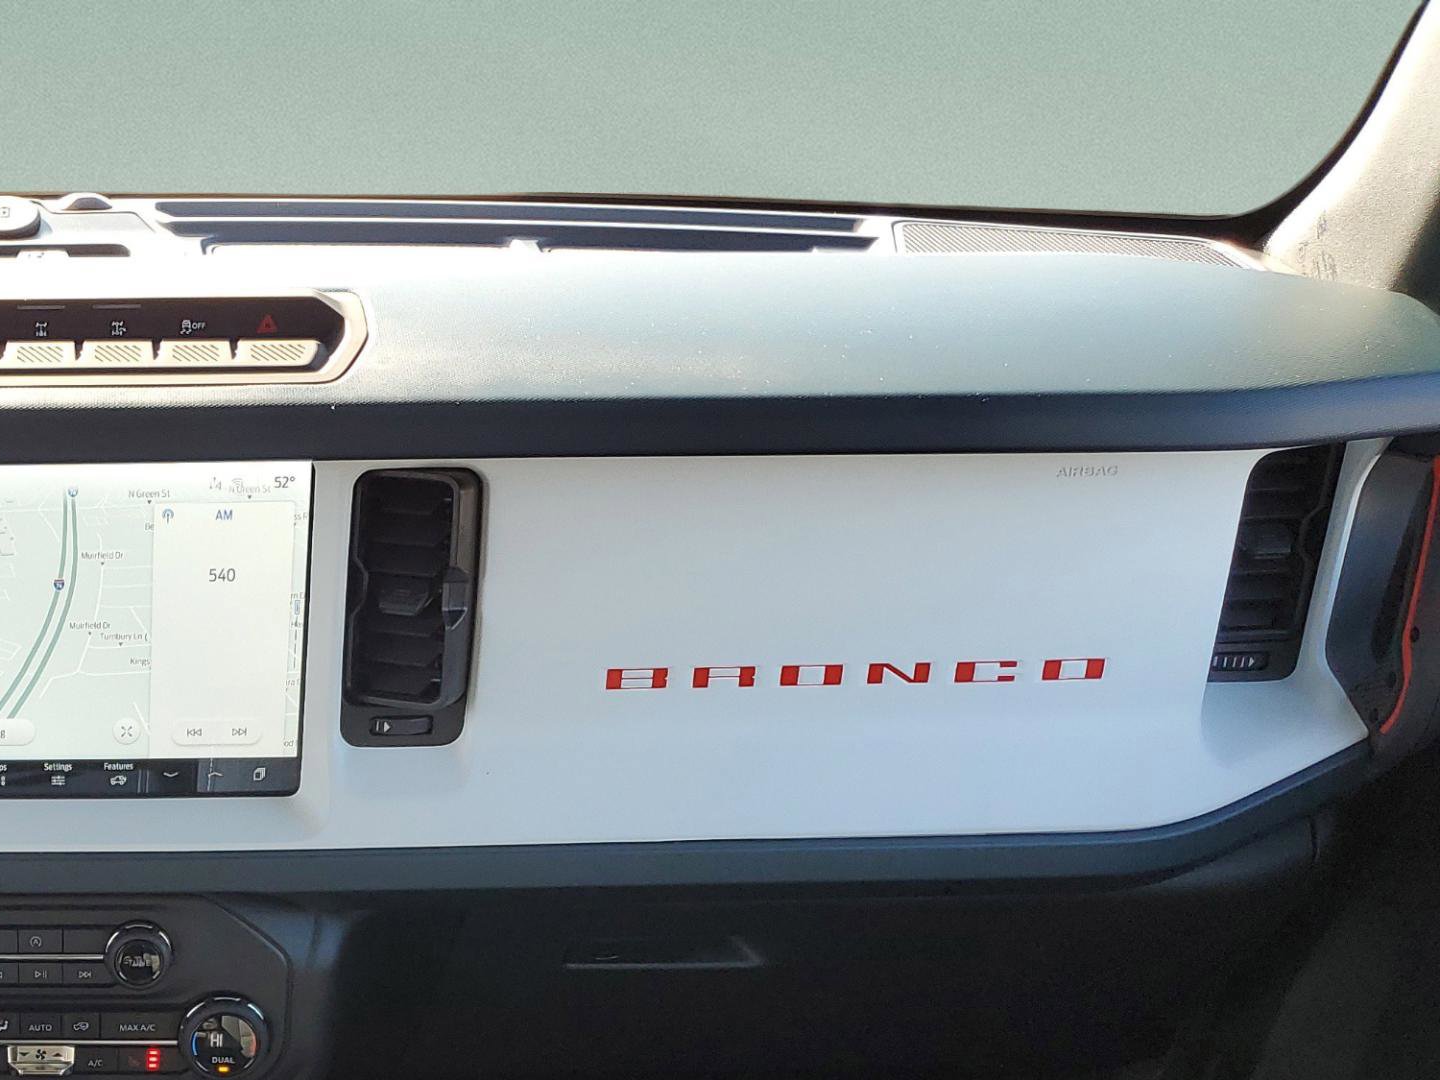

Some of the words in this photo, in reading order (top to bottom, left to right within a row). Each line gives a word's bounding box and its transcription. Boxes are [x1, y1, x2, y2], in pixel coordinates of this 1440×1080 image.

[191, 322, 206, 330] OFF
[1056, 464, 1119, 478] AIRBAG
[136, 489, 160, 498] Green
[161, 489, 170, 498] St
[215, 509, 233, 520] AM
[208, 567, 236, 582] 540
[605, 657, 1106, 690] BRONCO
[43, 762, 72, 773] Settings
[103, 762, 134, 771] Features
[28, 1024, 52, 1032] AUTO
[119, 1024, 138, 1032] MAX
[140, 1024, 156, 1032] A/C
[210, 1033, 223, 1048] HI
[88, 1059, 103, 1068] A/C
[211, 1056, 235, 1065] DUAL
